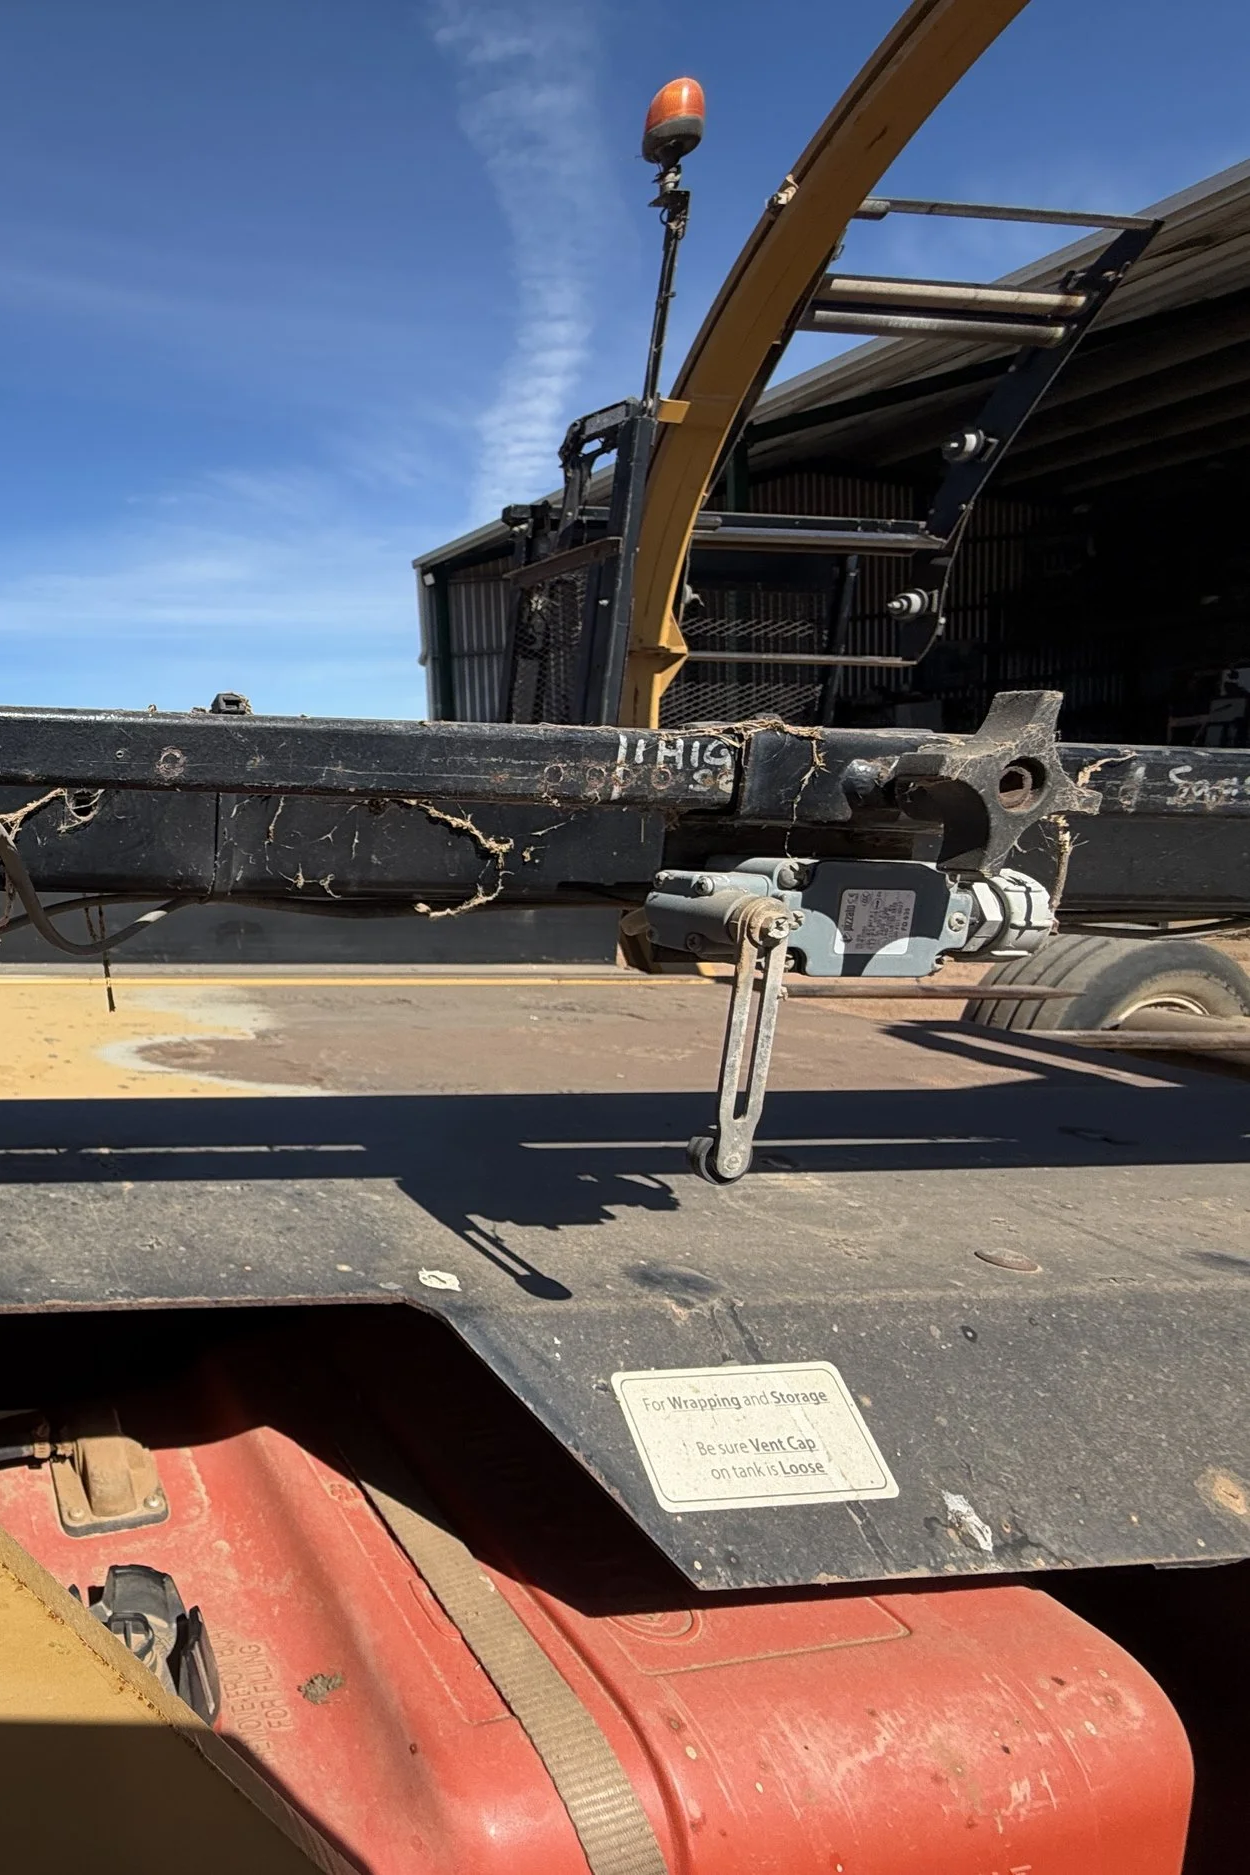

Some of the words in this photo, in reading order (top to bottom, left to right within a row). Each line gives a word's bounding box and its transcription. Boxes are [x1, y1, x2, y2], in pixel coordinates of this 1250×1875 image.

[642, 1397, 667, 1412] For
[666, 1394, 742, 1412] Wrapping
[742, 1391, 770, 1407] and
[770, 1389, 829, 1406] Storage
[696, 1441, 717, 1456] Be
[717, 1442, 750, 1455] sure
[748, 1437, 786, 1453] Vent
[786, 1435, 817, 1453] Cap
[711, 1467, 731, 1480] on
[731, 1461, 766, 1479] tank
[764, 1461, 779, 1476] is
[778, 1460, 826, 1476] Loose
